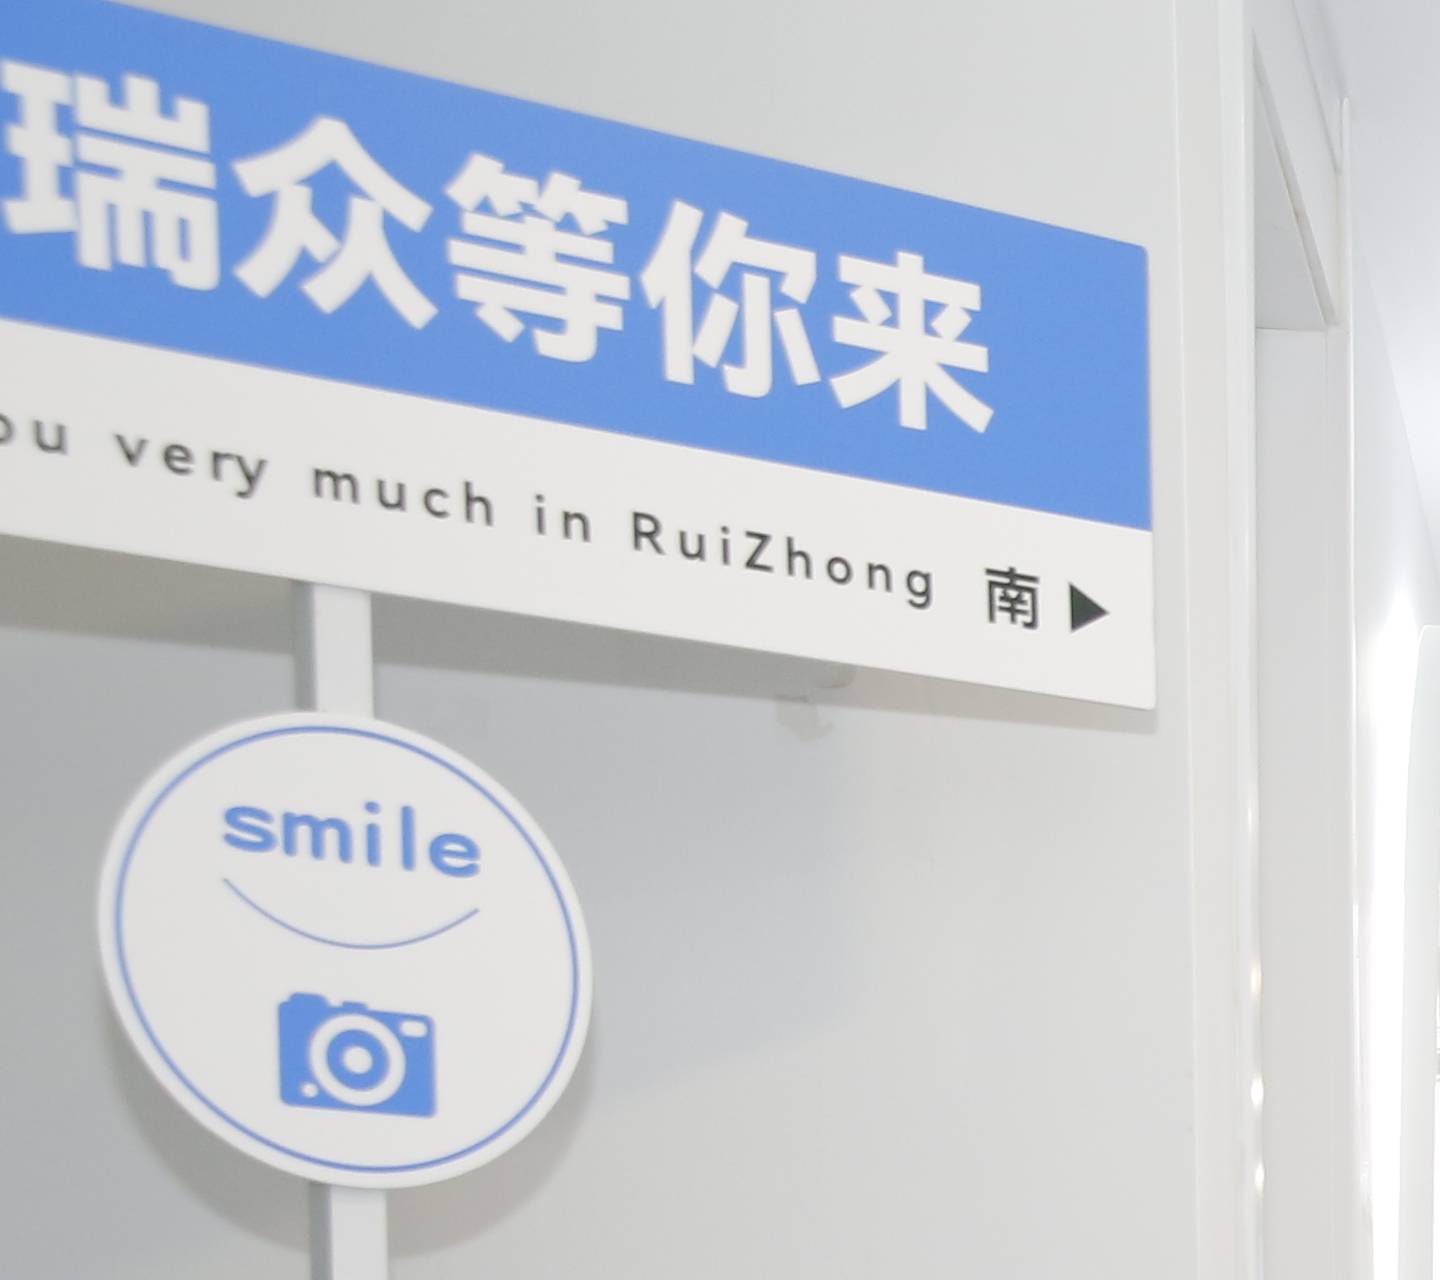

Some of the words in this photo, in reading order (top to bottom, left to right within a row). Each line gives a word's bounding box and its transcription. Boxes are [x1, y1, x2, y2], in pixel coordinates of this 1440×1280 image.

[0, 58, 995, 435] 瑞众等你来
[113, 433, 268, 500] very
[312, 467, 494, 528] much
[534, 493, 592, 544] in
[631, 511, 934, 611] RuiZhong
[984, 565, 1041, 631] 南
[222, 801, 481, 879] smile
